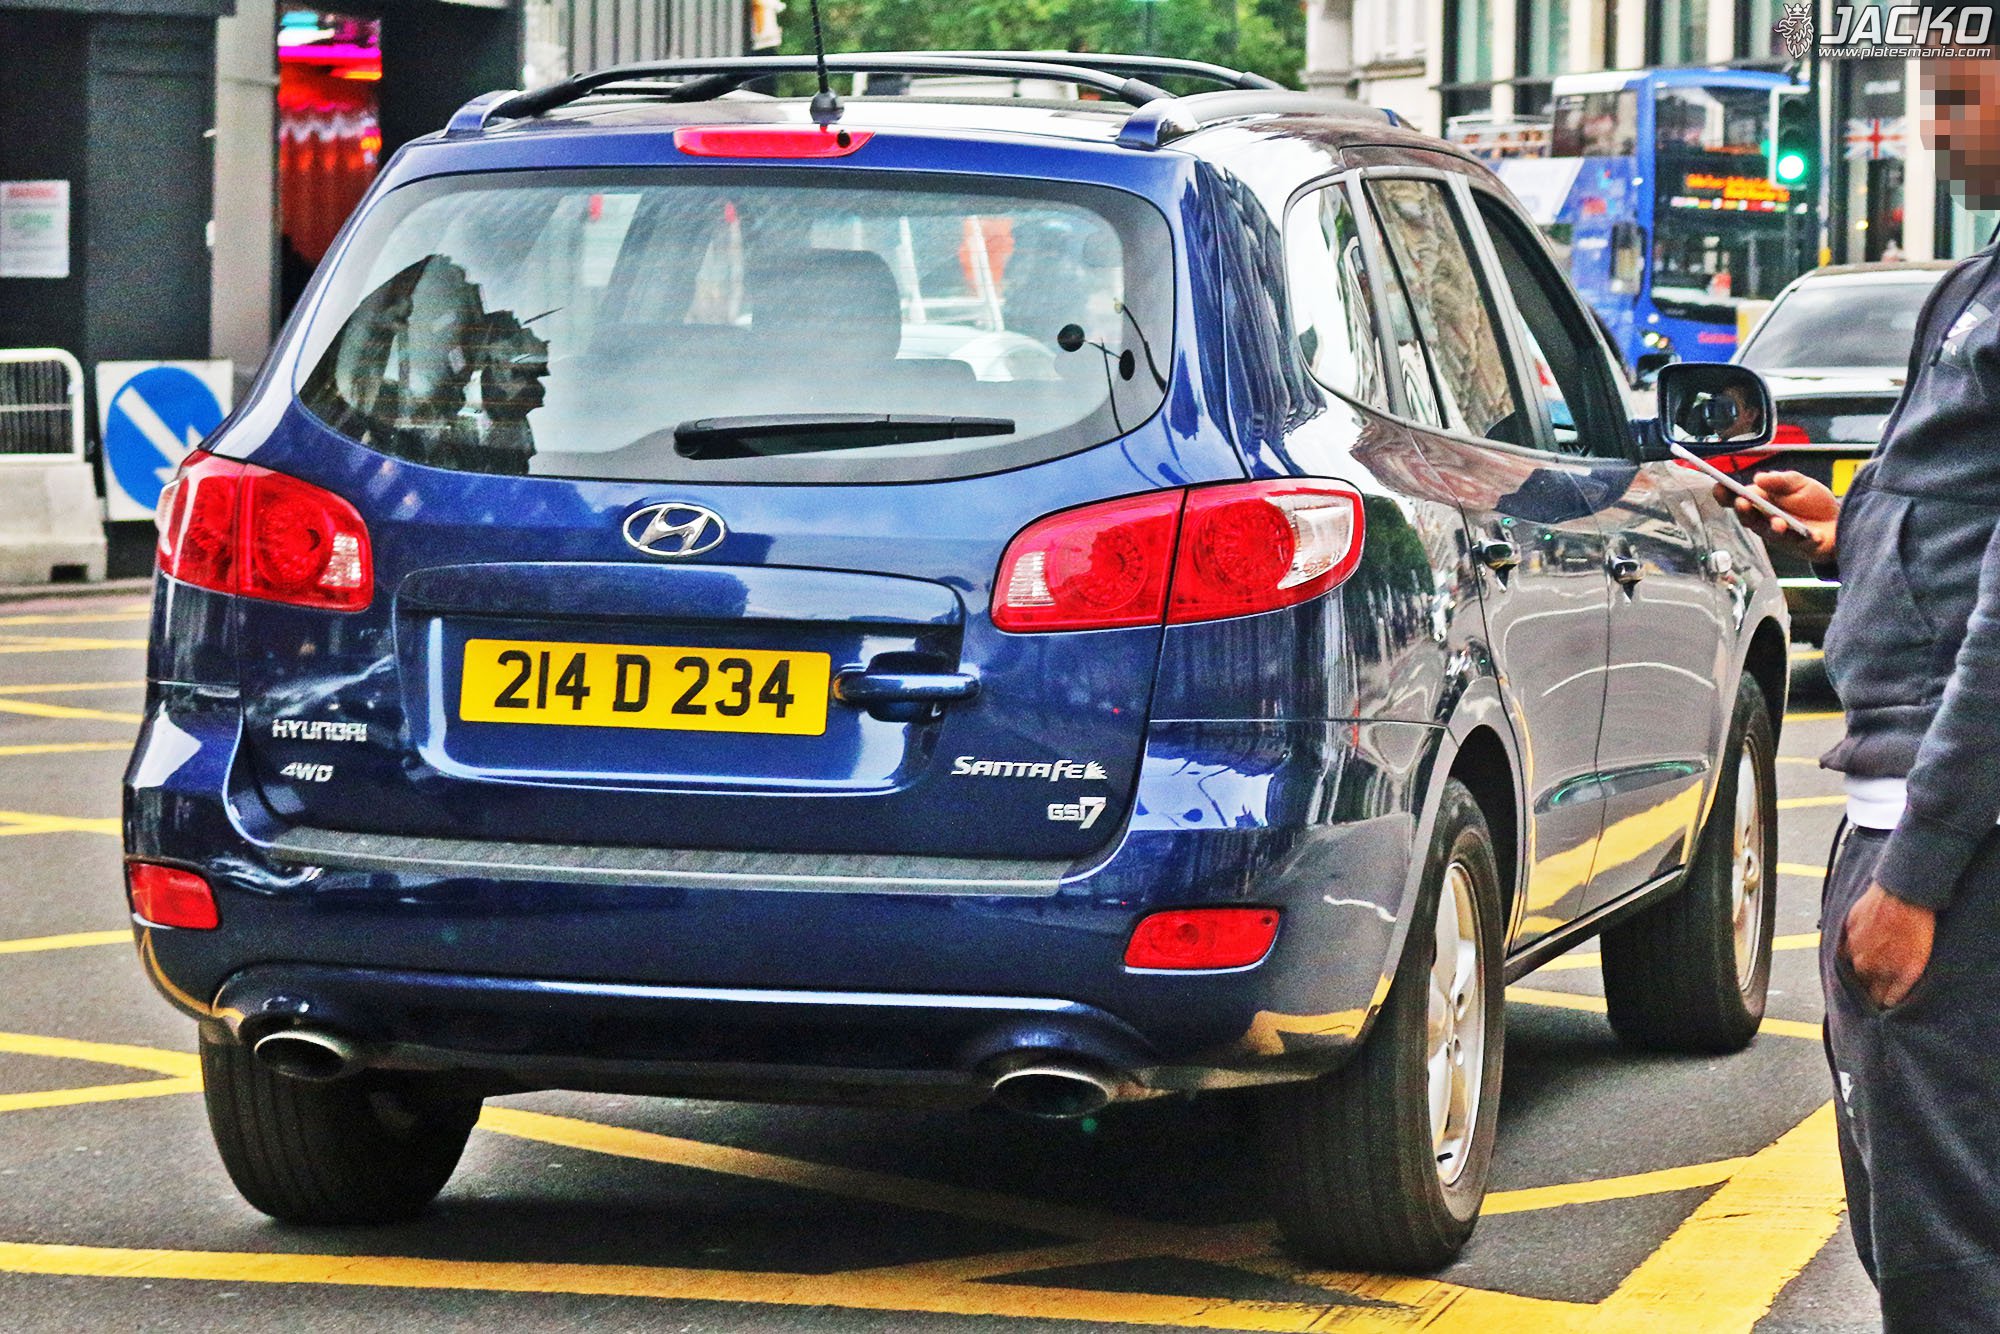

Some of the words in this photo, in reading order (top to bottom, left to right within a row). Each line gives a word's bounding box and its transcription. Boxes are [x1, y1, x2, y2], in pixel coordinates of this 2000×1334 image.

[494, 650, 591, 711] 214
[612, 653, 651, 713] D
[671, 656, 795, 718] 234
[272, 719, 368, 742] HYUNDAI
[280, 762, 334, 782] 4WD
